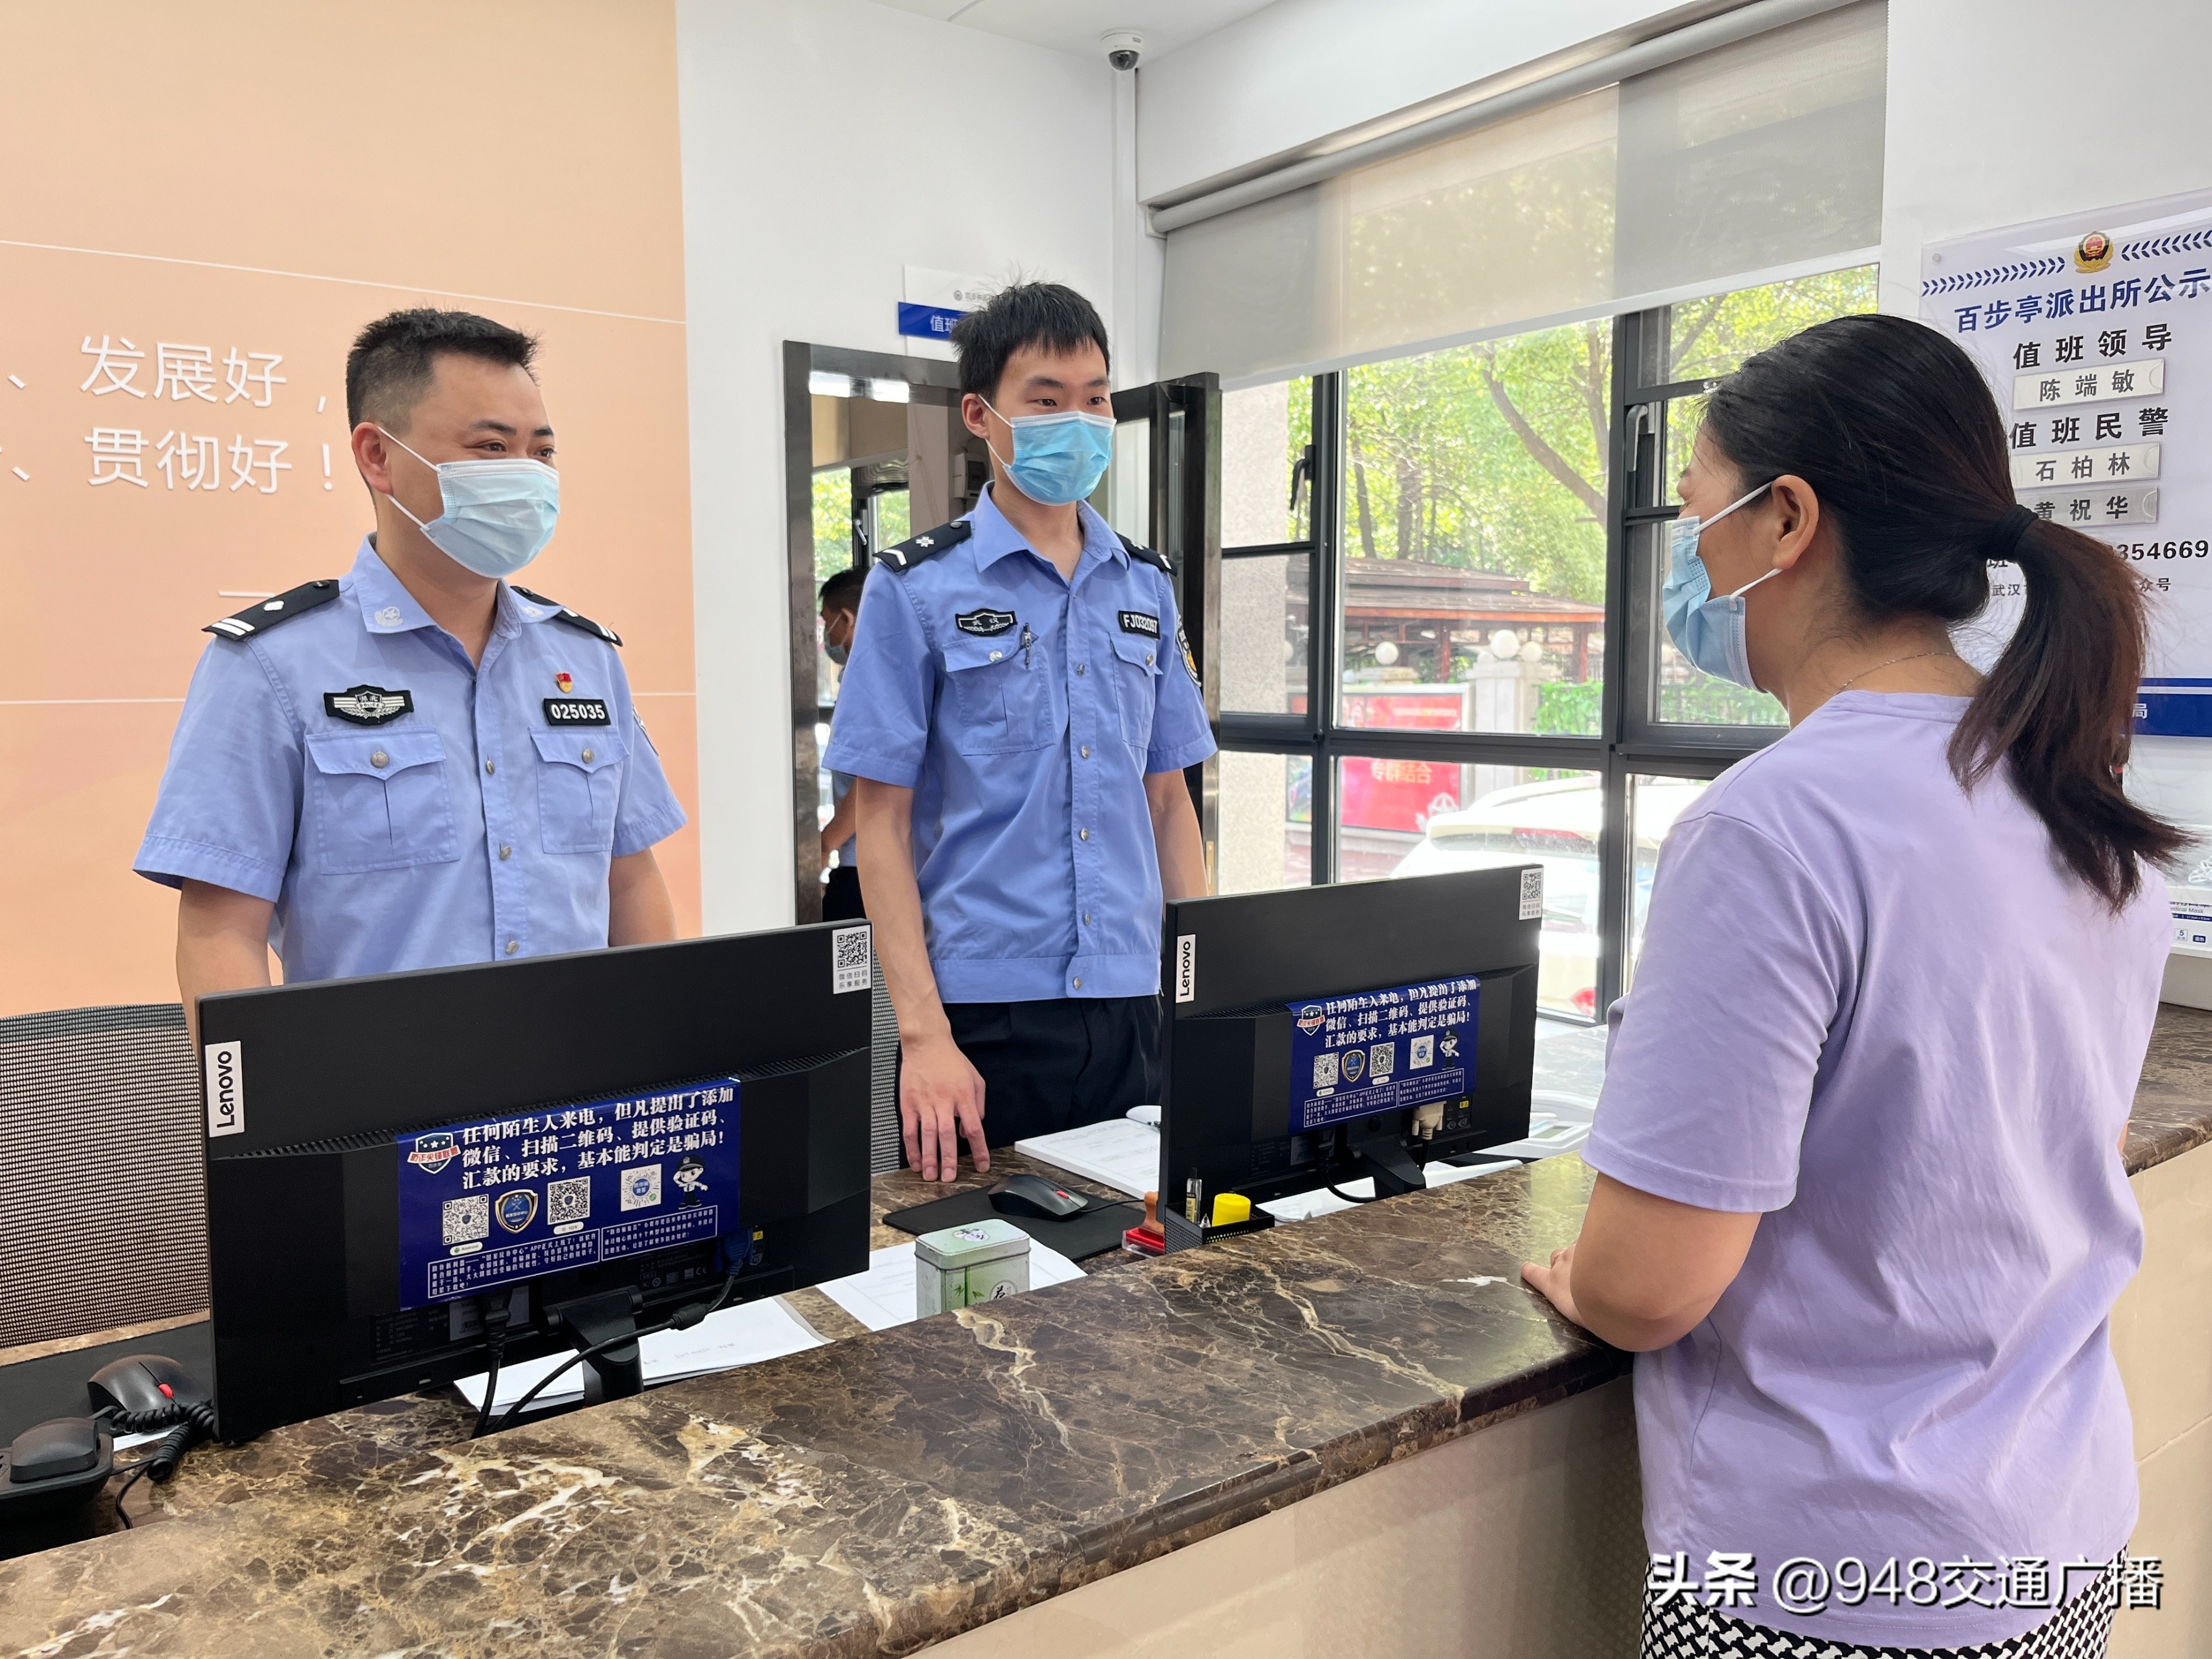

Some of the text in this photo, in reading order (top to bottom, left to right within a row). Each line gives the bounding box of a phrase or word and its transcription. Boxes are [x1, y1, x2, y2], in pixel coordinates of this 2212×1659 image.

[1955, 267, 2211, 333] 百步亭派出所公示
[2013, 323, 2172, 370] 值班领导
[2039, 369, 2135, 402] 陈端敏
[2009, 406, 2168, 449] 值班民警
[2036, 452, 2130, 482] 石柏林
[2034, 496, 2129, 521] 黄祝华
[551, 703, 605, 719] 025035
[1180, 941, 1191, 996] Lenovo
[217, 1051, 235, 1128] Lenovo
[462, 1112, 728, 1167] 微信、扫描二维码、提供验证码、
[463, 1087, 734, 1145] 任何陌生人来电，但凡提出了添加
[462, 1129, 725, 1190] 汇款的要求，基本能判定是骗局！
